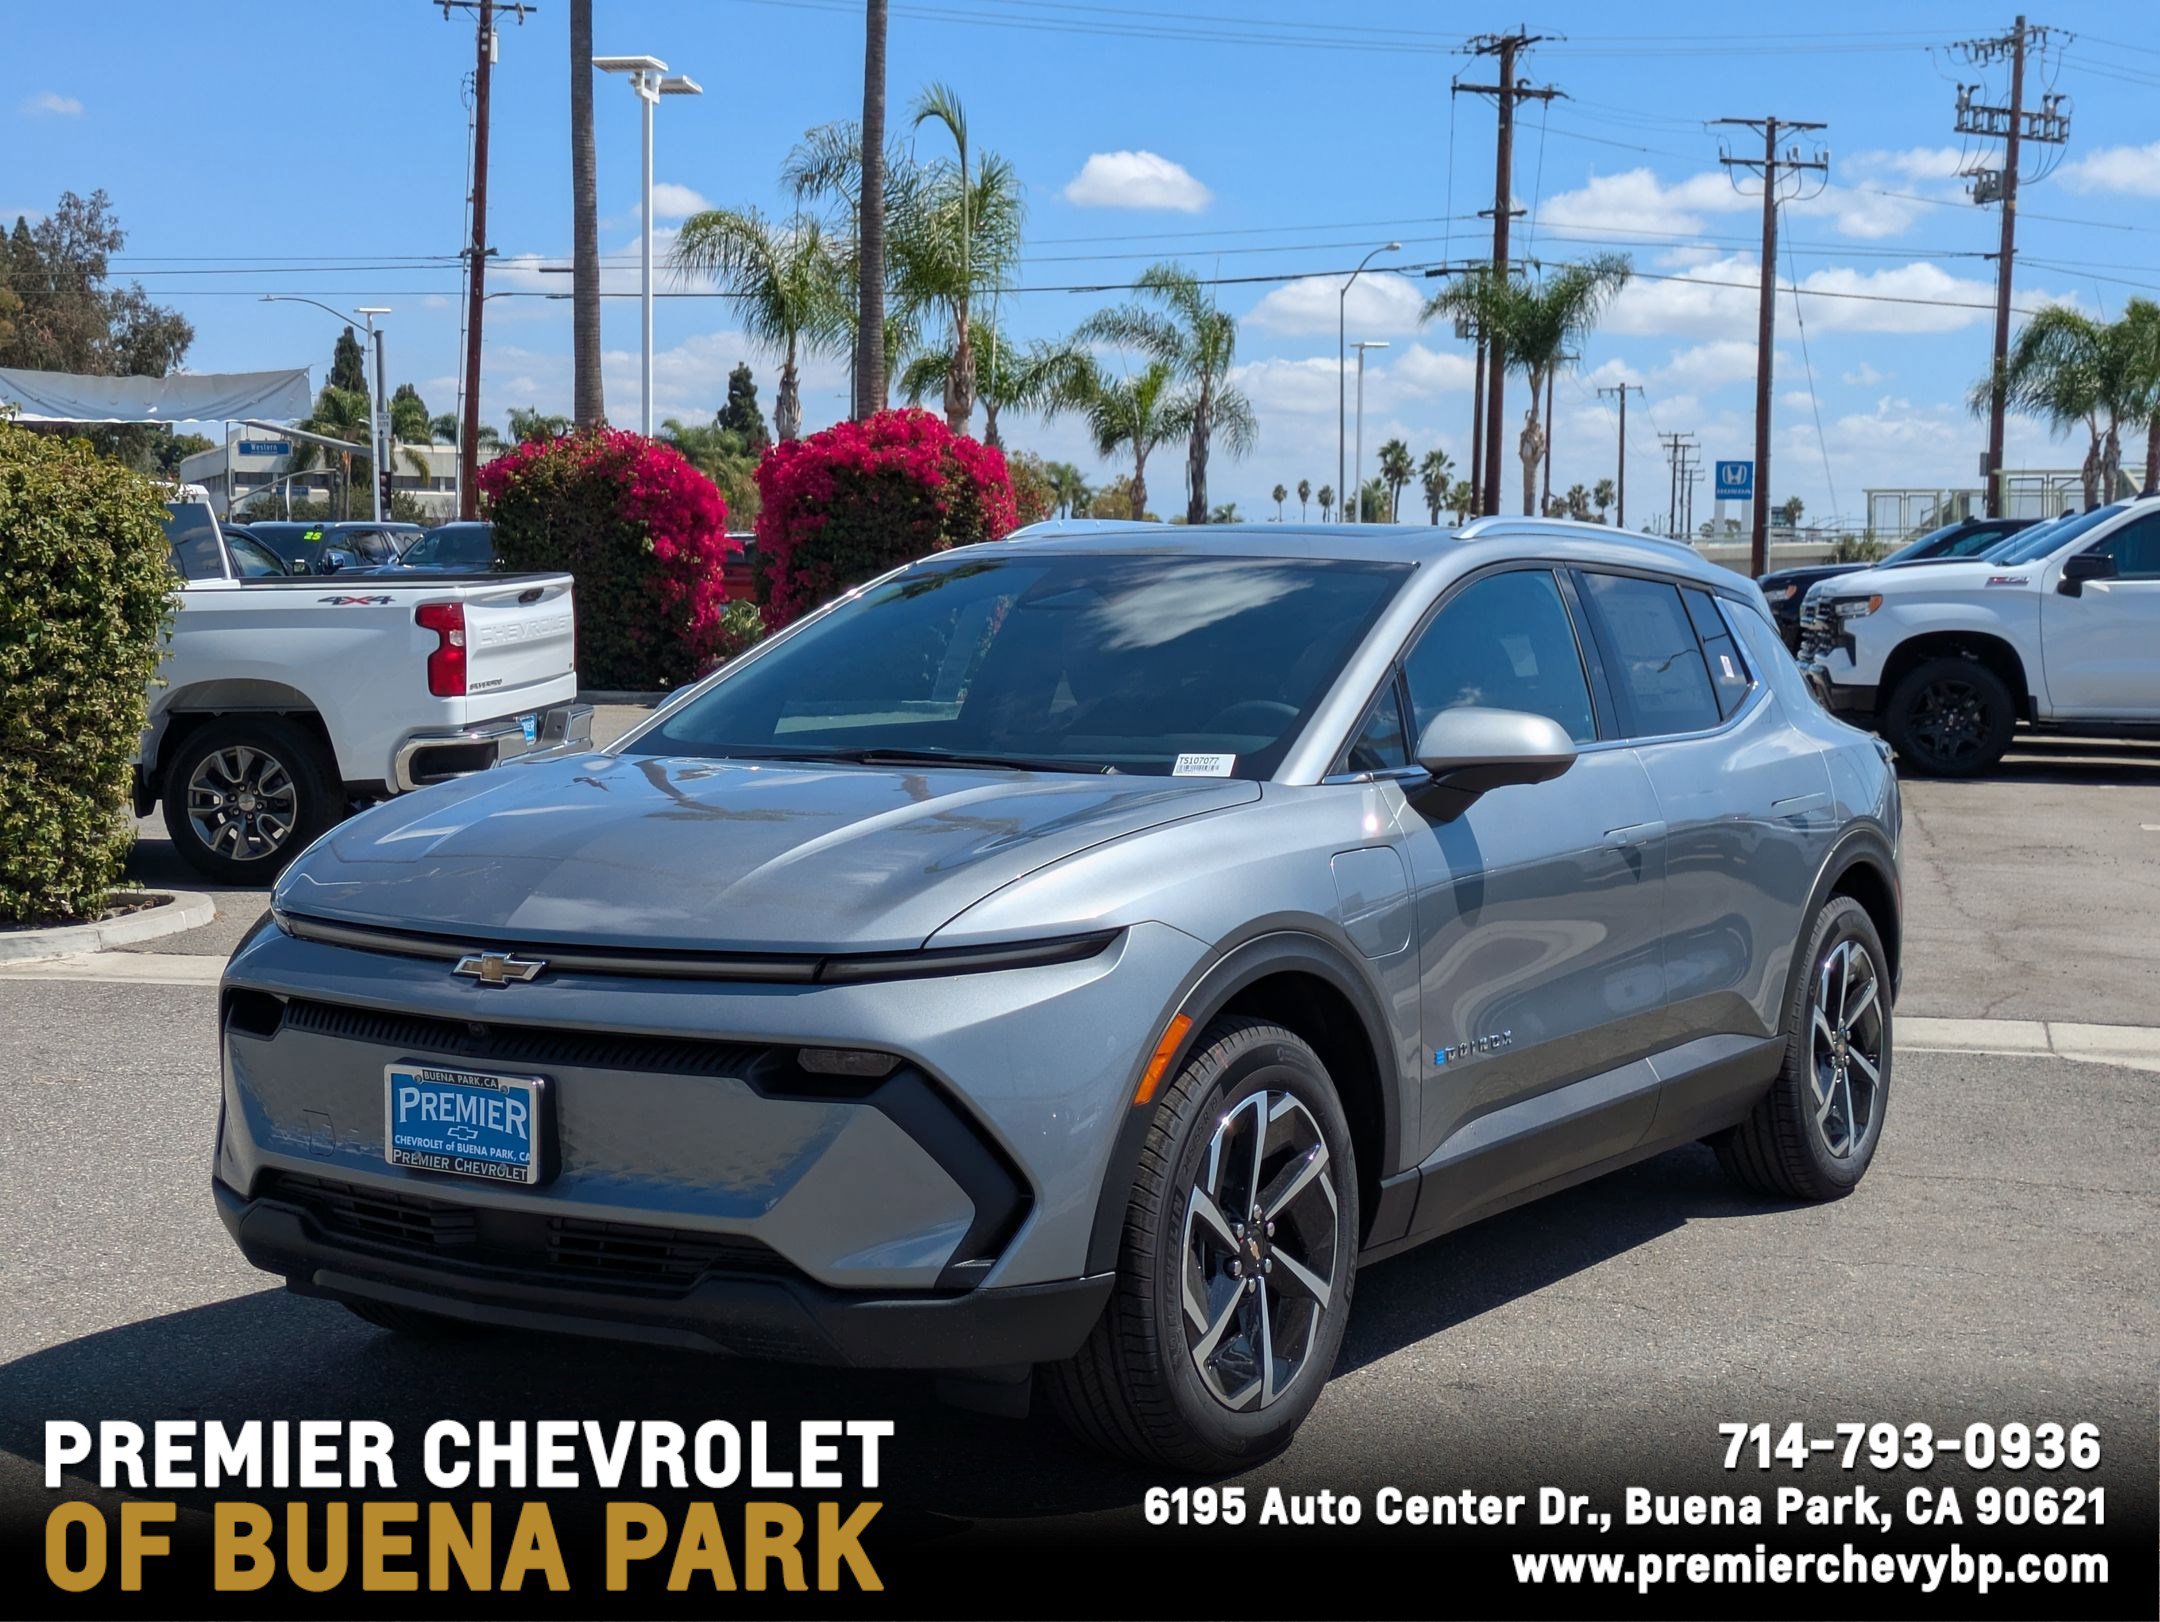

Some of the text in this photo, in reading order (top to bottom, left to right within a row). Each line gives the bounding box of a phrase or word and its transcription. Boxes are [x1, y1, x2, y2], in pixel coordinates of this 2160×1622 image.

[303, 531, 323, 541] 25
[480, 615, 573, 645] CHEVROLET
[1179, 756, 1220, 765] TS107077
[423, 1070, 455, 1083] BUENA
[484, 1078, 497, 1088] CA
[398, 1086, 529, 1141] PREMIER
[394, 1134, 443, 1150] CHEVROLET
[445, 1142, 456, 1152] of
[457, 1143, 488, 1157] BUENA
[490, 1147, 517, 1162] PARK,
[393, 1149, 528, 1181] PREMIER CHEVROLET
